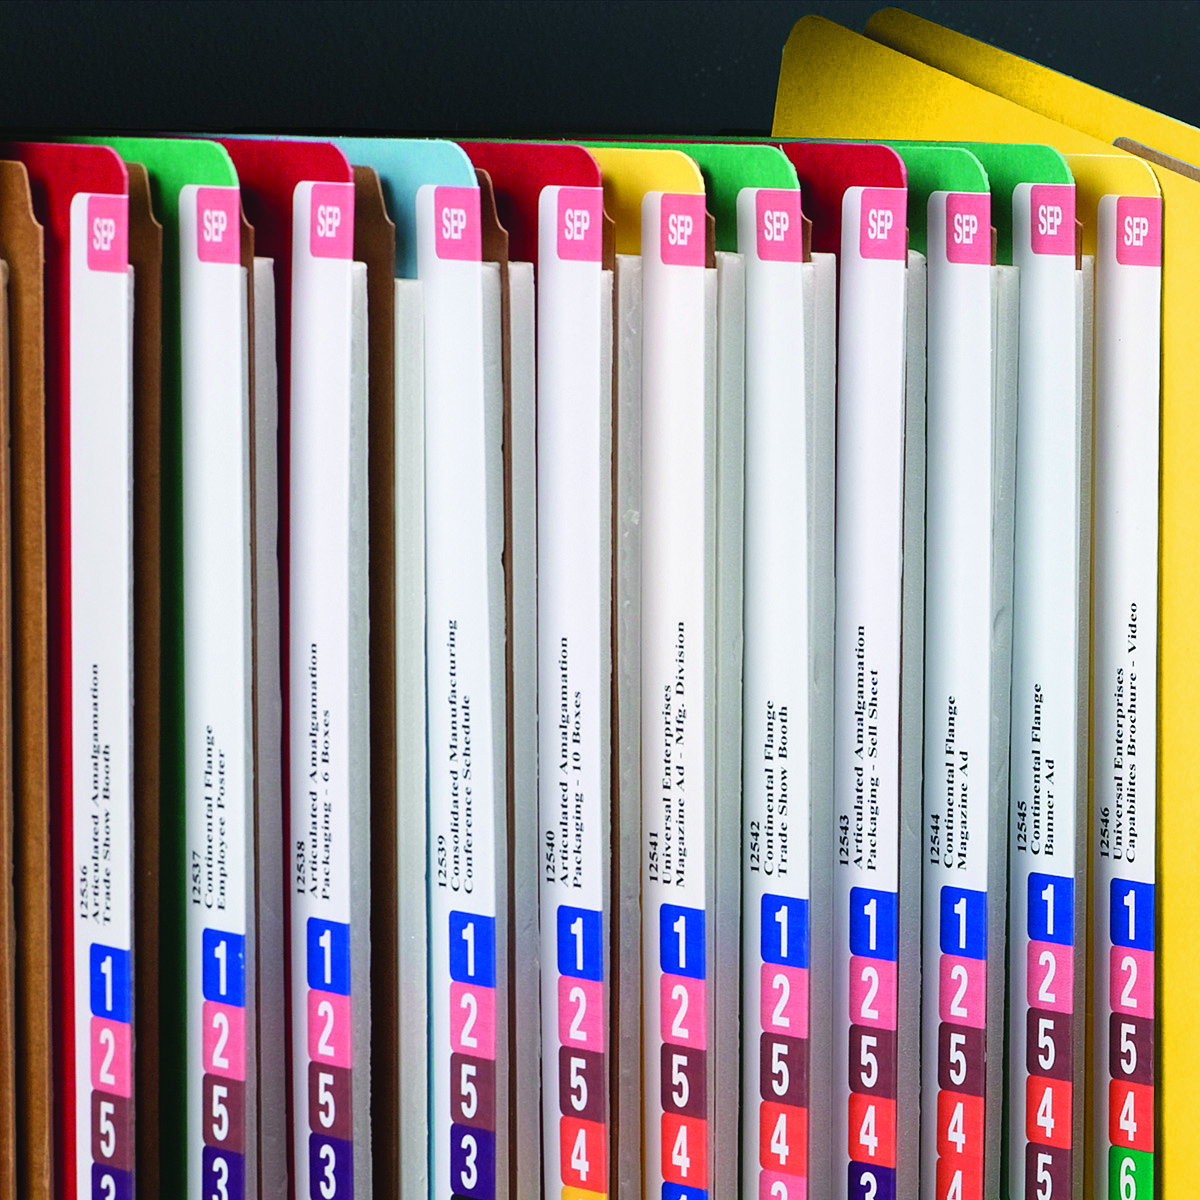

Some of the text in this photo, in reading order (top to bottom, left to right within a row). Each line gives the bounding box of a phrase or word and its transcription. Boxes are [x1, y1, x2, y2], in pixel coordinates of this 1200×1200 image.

[92, 216, 117, 252] SEP
[202, 208, 228, 243] SEP
[316, 203, 342, 239] SEP
[441, 206, 467, 241] SEP
[563, 207, 591, 241] SEP
[667, 213, 694, 247] SEP
[763, 209, 790, 242] SEP
[867, 207, 894, 241] SEP
[953, 212, 979, 245] SEP
[1123, 215, 1149, 247] SEP
[445, 618, 461, 893] Consolidated Manufacturing
[1029, 682, 1044, 856] Continental Flange
[89, 663, 102, 925] Articulated Amalgamation
[460, 694, 474, 896] Conference Schedule
[763, 699, 777, 877] Continental Flange
[777, 705, 789, 878] Trade Show Booth
[1043, 758, 1056, 857] Banner Ad
[101, 743, 112, 927] Trade Show Booth
[203, 724, 216, 910] Continental Flange
[215, 748, 229, 912] Employee Poster
[1016, 799, 1028, 853] 12545
[436, 833, 448, 889] 12539
[749, 820, 761, 873] 12542
[78, 864, 89, 920] 12536
[191, 849, 202, 906] 12537
